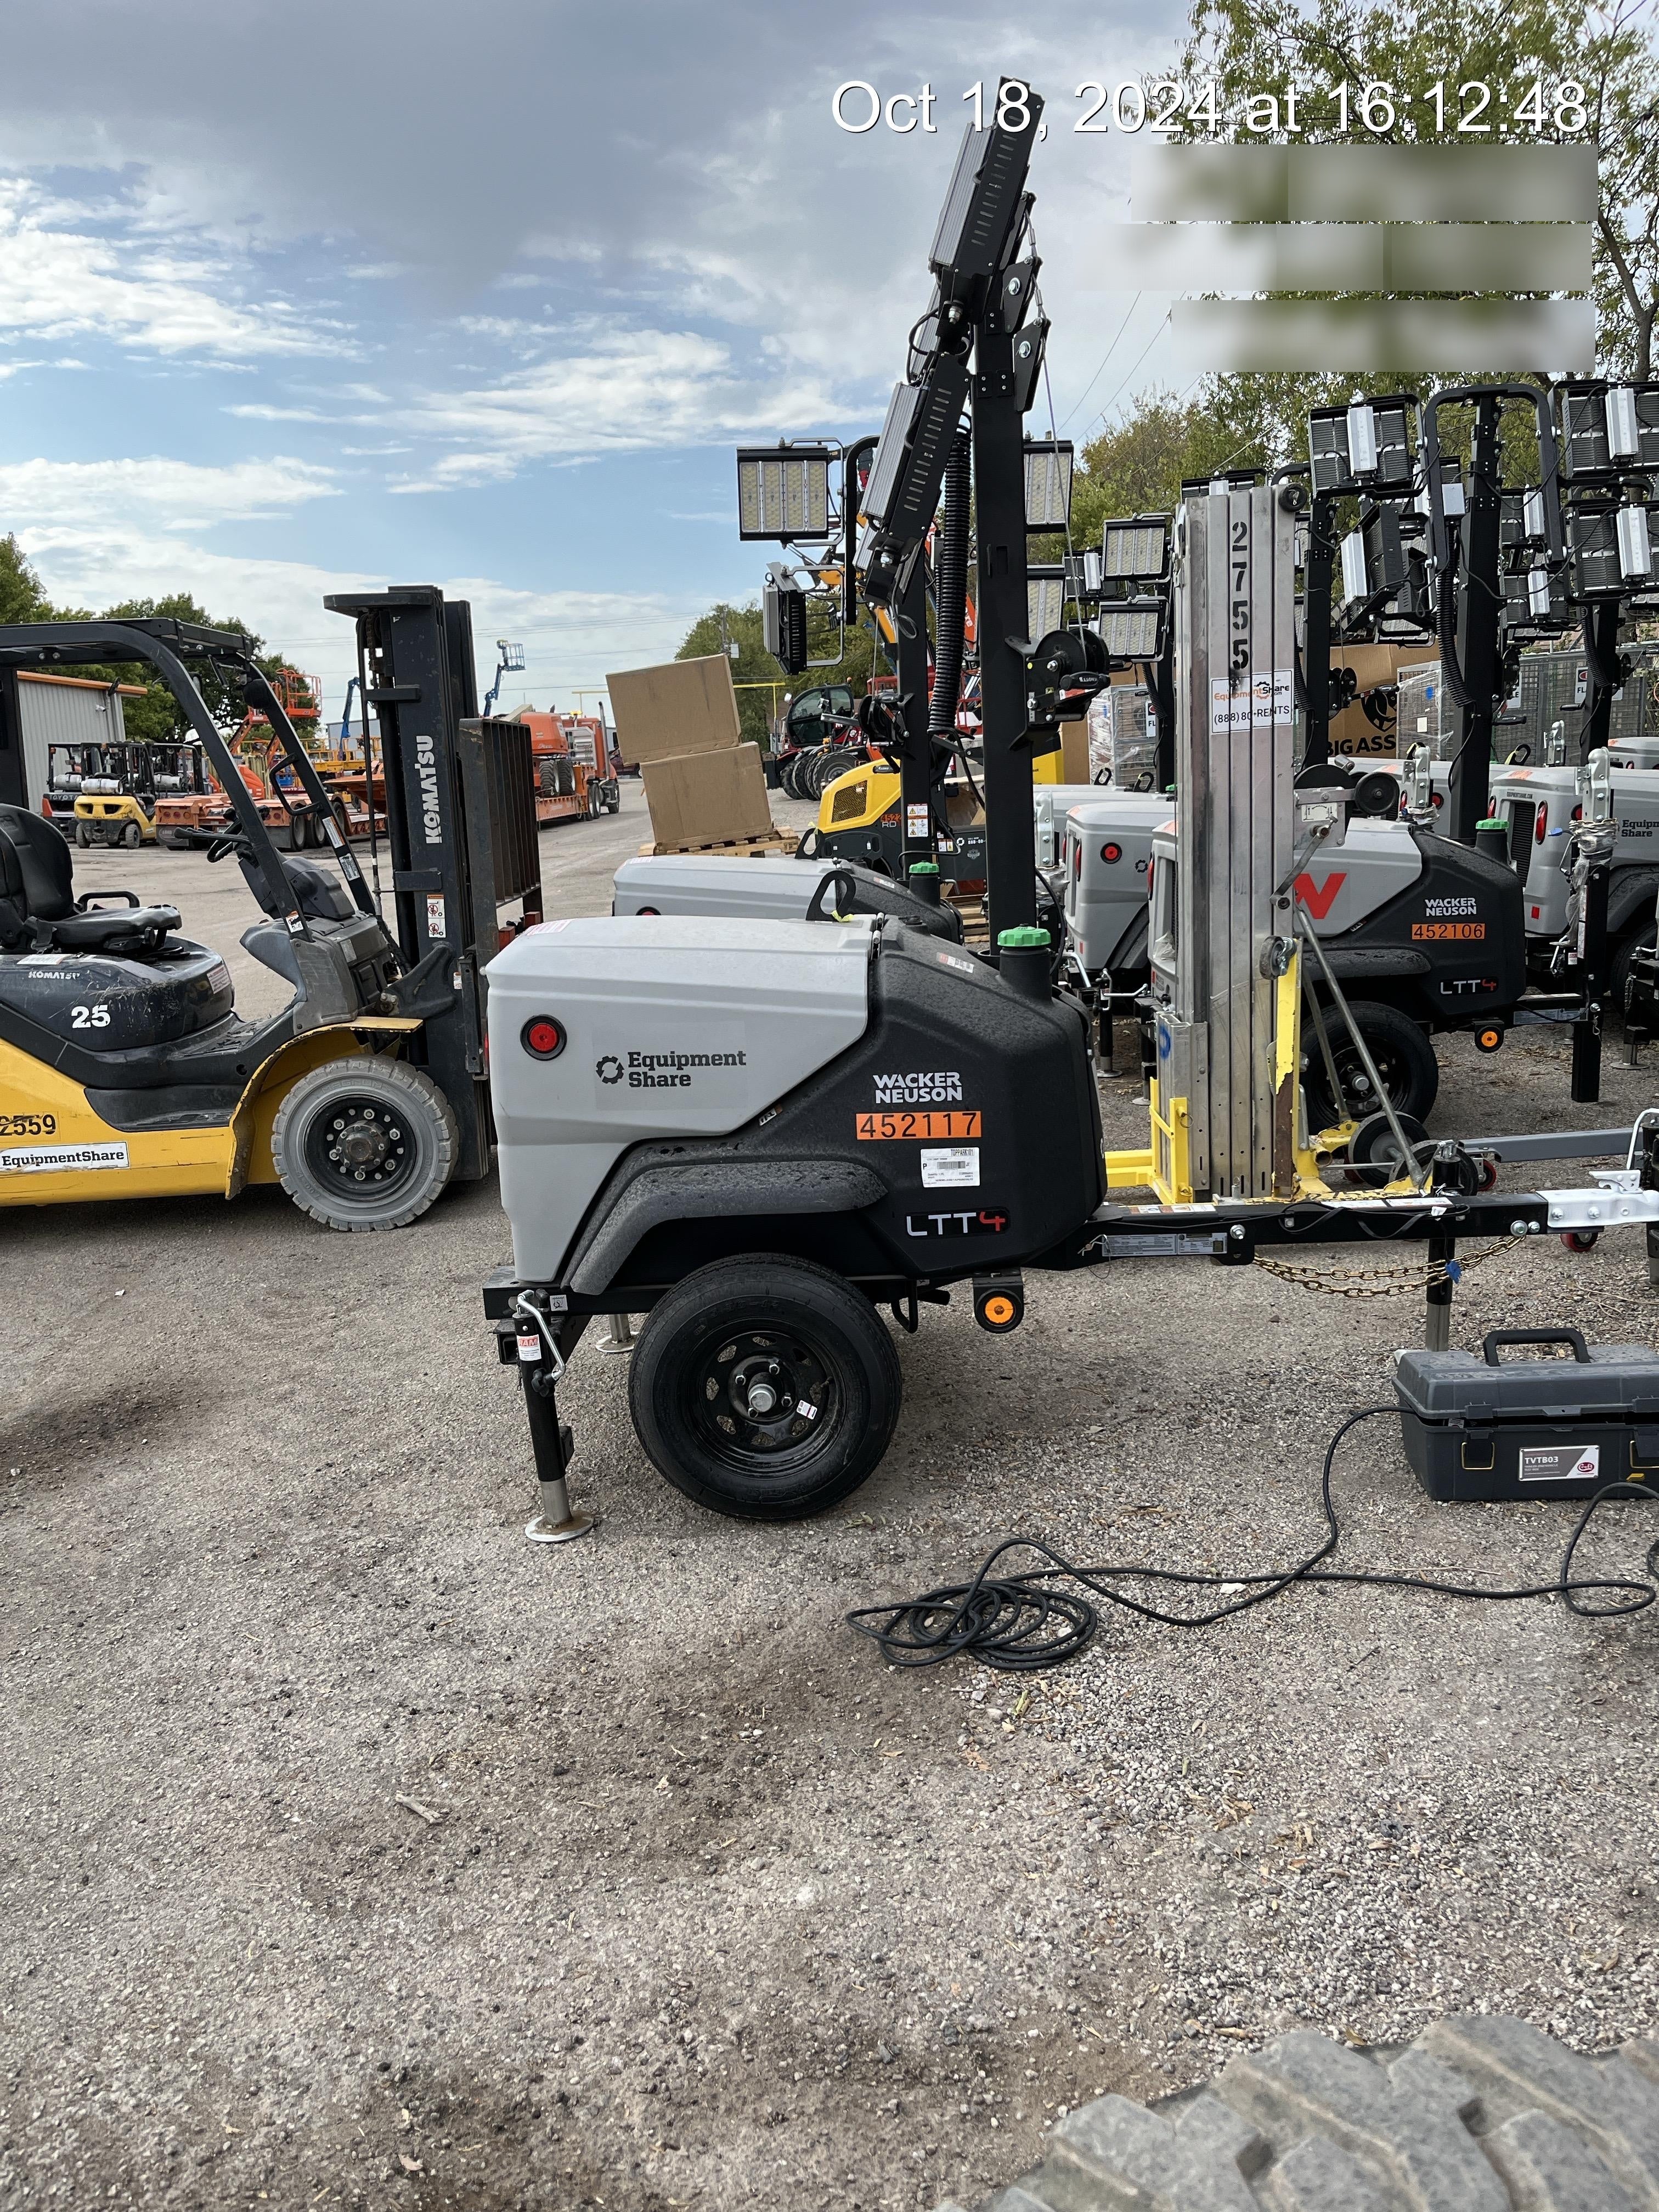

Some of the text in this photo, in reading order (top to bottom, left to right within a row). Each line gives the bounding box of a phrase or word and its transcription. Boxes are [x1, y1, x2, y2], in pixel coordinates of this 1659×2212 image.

[1232, 522, 1249, 670] 27755
[1356, 734, 1396, 753] ASS
[415, 736, 443, 844] KOMATSU
[1425, 898, 1476, 907] WACKER
[1426, 906, 1477, 916] NEUSON
[1414, 924, 1483, 938] 452106
[1441, 979, 1497, 994] LTT4
[71, 1005, 111, 1029] 25
[628, 1051, 746, 1071] Equipment
[629, 1071, 691, 1087] Share
[873, 1072, 962, 1088] WACKER
[876, 1087, 962, 1104] NEUSON
[860, 1113, 977, 1138] 452117
[2, 1151, 125, 1167] EquipmentShare
[906, 1211, 1006, 1236] LTT4
[1524, 1456, 1559, 1464] TVTB03
